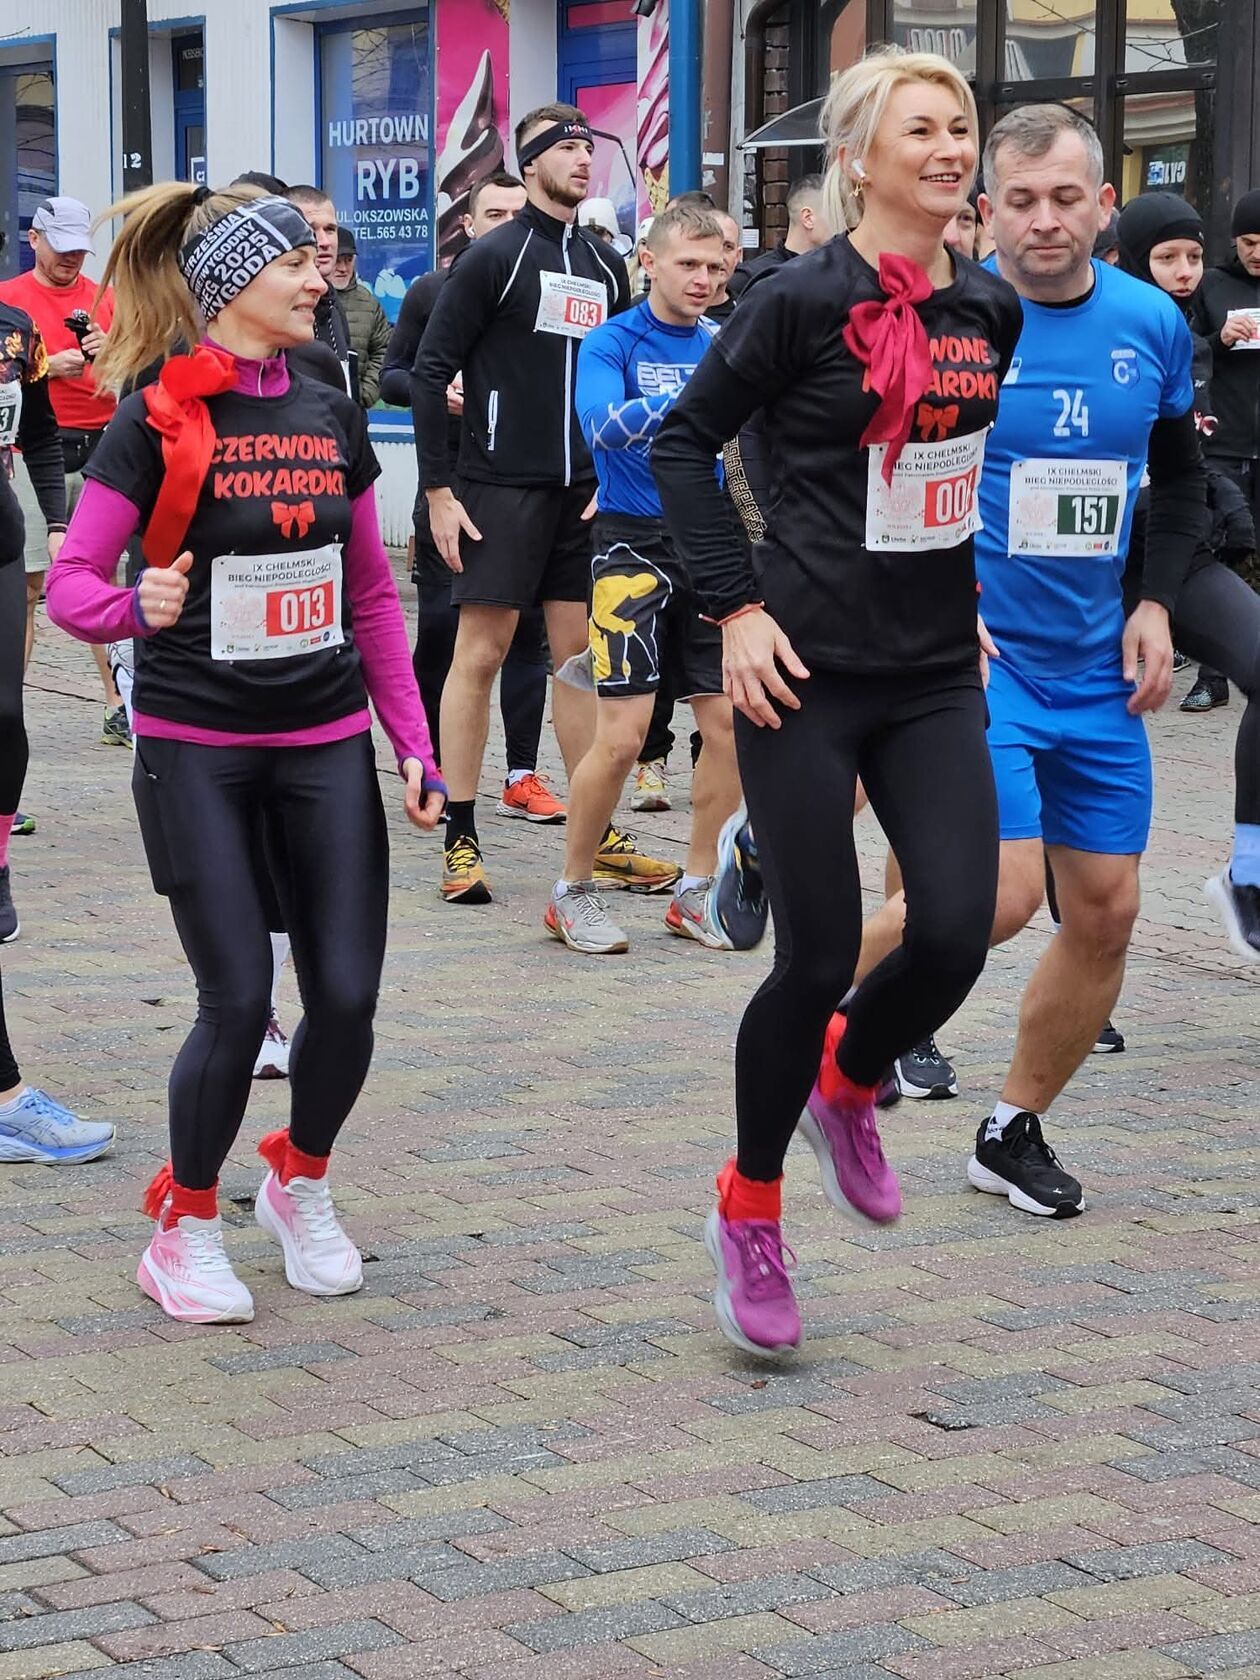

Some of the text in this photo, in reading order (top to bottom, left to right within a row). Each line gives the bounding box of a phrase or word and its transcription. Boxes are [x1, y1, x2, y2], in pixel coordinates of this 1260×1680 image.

[329, 114, 428, 147] HURTOWN
[358, 158, 419, 200] RYB
[398, 225, 411, 238] 43
[415, 225, 428, 238] 78
[214, 230, 269, 281] 2025
[570, 300, 598, 327] 083
[1052, 388, 1089, 437] 24
[214, 468, 344, 499] KOKARDKI
[936, 471, 974, 523] 00
[1071, 496, 1108, 533] 151
[228, 574, 252, 582] BIEG
[253, 564, 262, 572] IX
[280, 587, 326, 633] 013
